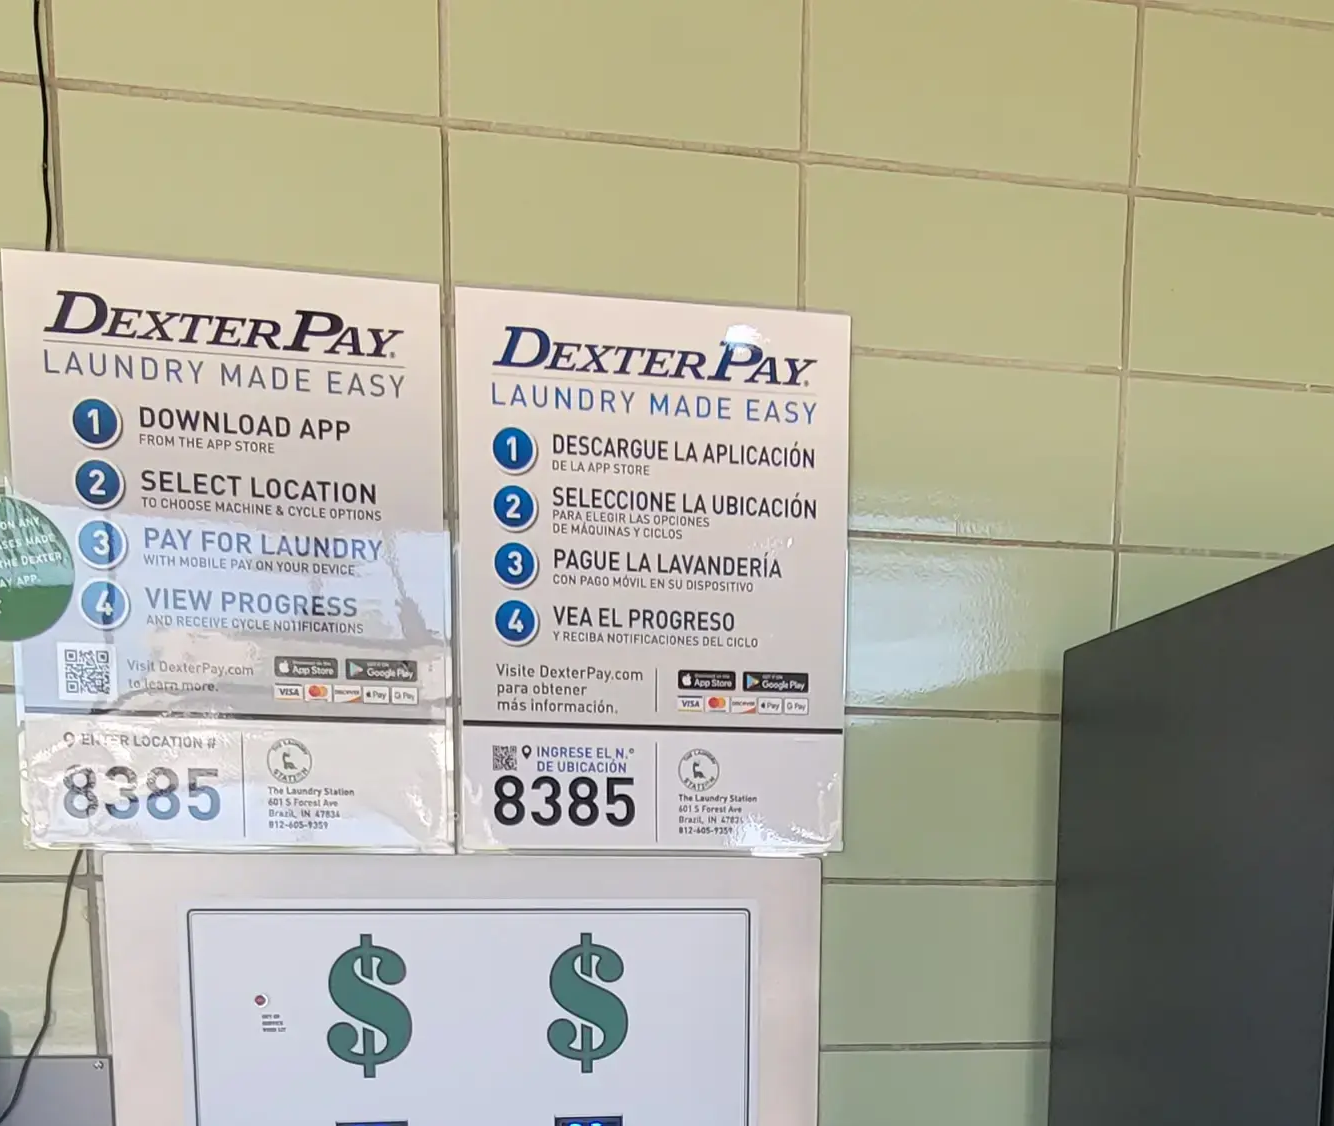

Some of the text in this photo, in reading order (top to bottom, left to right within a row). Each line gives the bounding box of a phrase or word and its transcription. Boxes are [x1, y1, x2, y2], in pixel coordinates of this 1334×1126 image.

[43, 349, 404, 398] LAUNDRY MADE EASY
[492, 382, 817, 424] LAUNDRY MADE EASY
[87, 406, 351, 441] 1 DOWNLOAD APP
[139, 434, 275, 453] FROM THE APP STORE
[506, 434, 814, 469] 1 DESCARGUE LA APLICACIÓN
[89, 470, 377, 504] 2 SELECT LOCATION
[506, 488, 817, 519] 2 SELECCIONE LA UBICACIÓN
[0, 521, 15, 530] ON
[19, 517, 40, 527] ANY
[26, 533, 55, 546] MADE
[93, 526, 383, 560] 3 PAY FOR LAUNDRY
[21, 552, 62, 566] DEXTER
[508, 550, 782, 578] 3 PAGUE LA LAVANDERÍA
[95, 587, 357, 618] 4 VIEW PROGRESS
[508, 606, 734, 633] 4 VEA EL PROGRESO
[496, 664, 643, 682] Visite DexterPay.com
[694, 679, 710, 688] App
[762, 680, 805, 690] Google Play
[537, 746, 611, 759] INGRESE EL
[537, 759, 626, 773] DE UBICACIÓN
[63, 765, 220, 821] 8385
[268, 786, 354, 799] The Laundry Station
[494, 775, 635, 826] 8385
[327, 934, 413, 1078] $
[547, 932, 628, 1073] $
